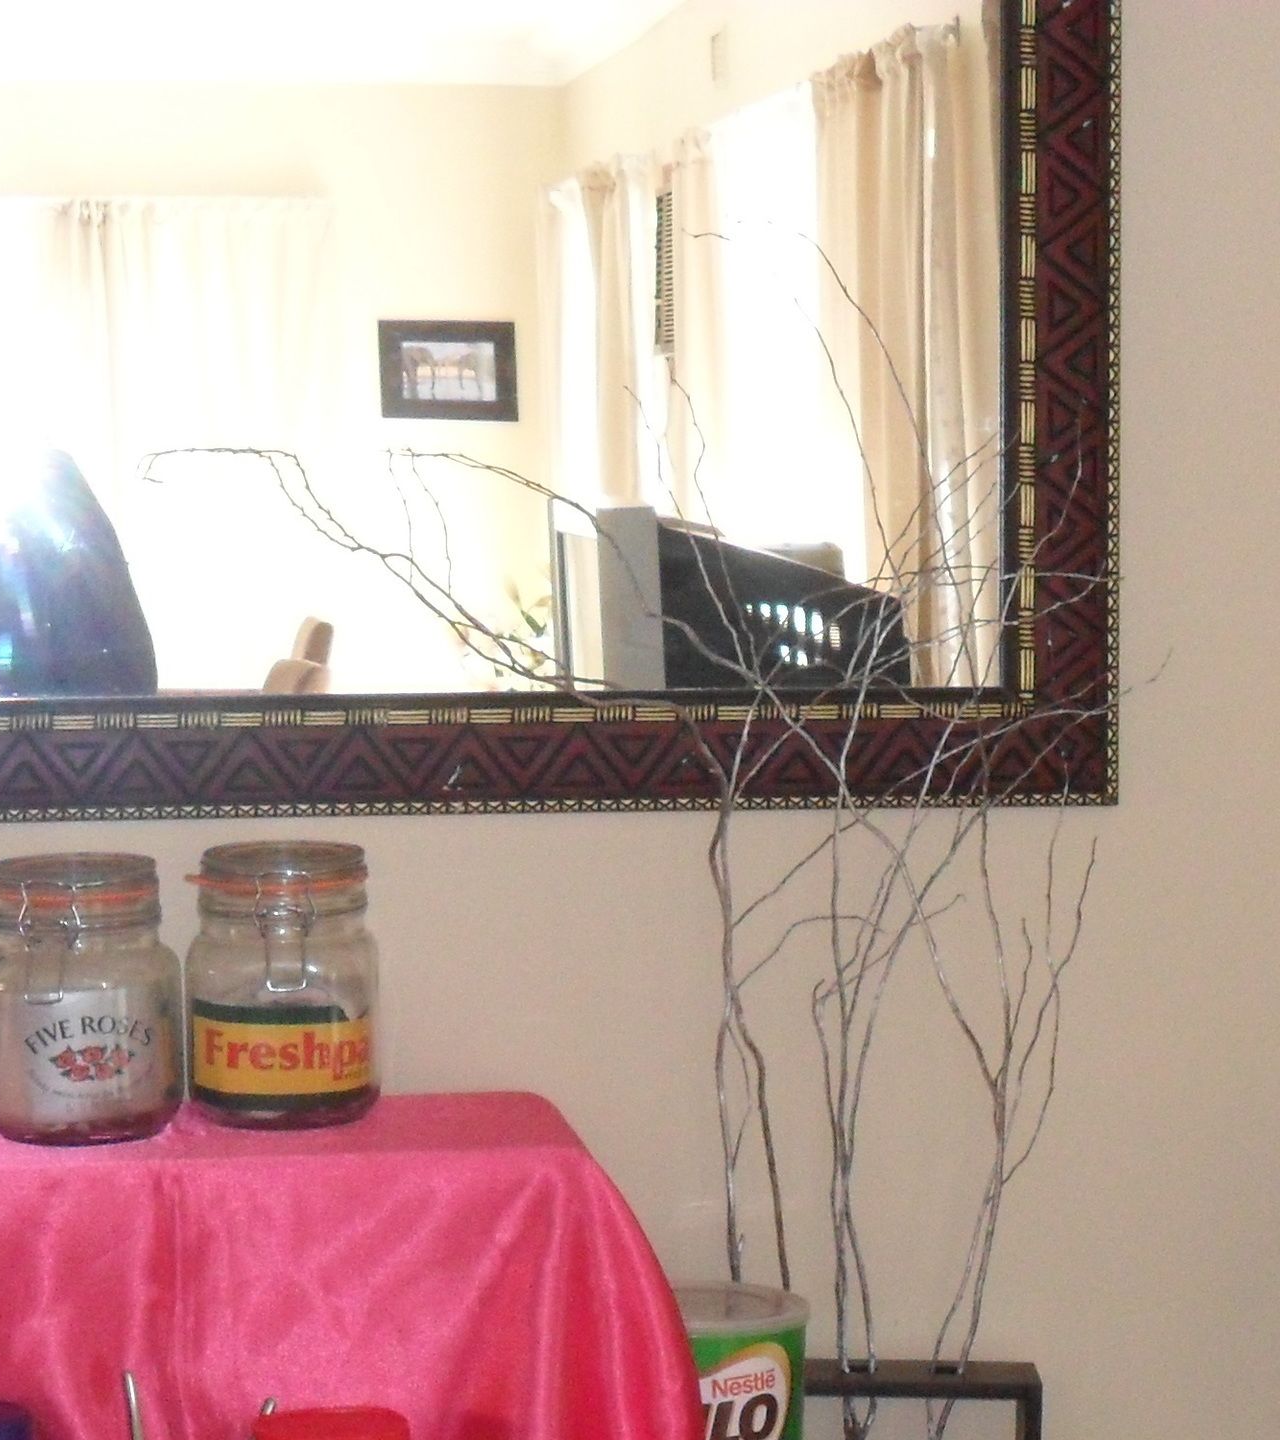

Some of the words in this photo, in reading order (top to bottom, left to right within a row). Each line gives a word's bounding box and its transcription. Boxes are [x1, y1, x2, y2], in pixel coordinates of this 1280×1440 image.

[24, 1018, 73, 1055] FIVE
[80, 1014, 153, 1046] ROSES
[711, 1367, 776, 1399] Nestlé
